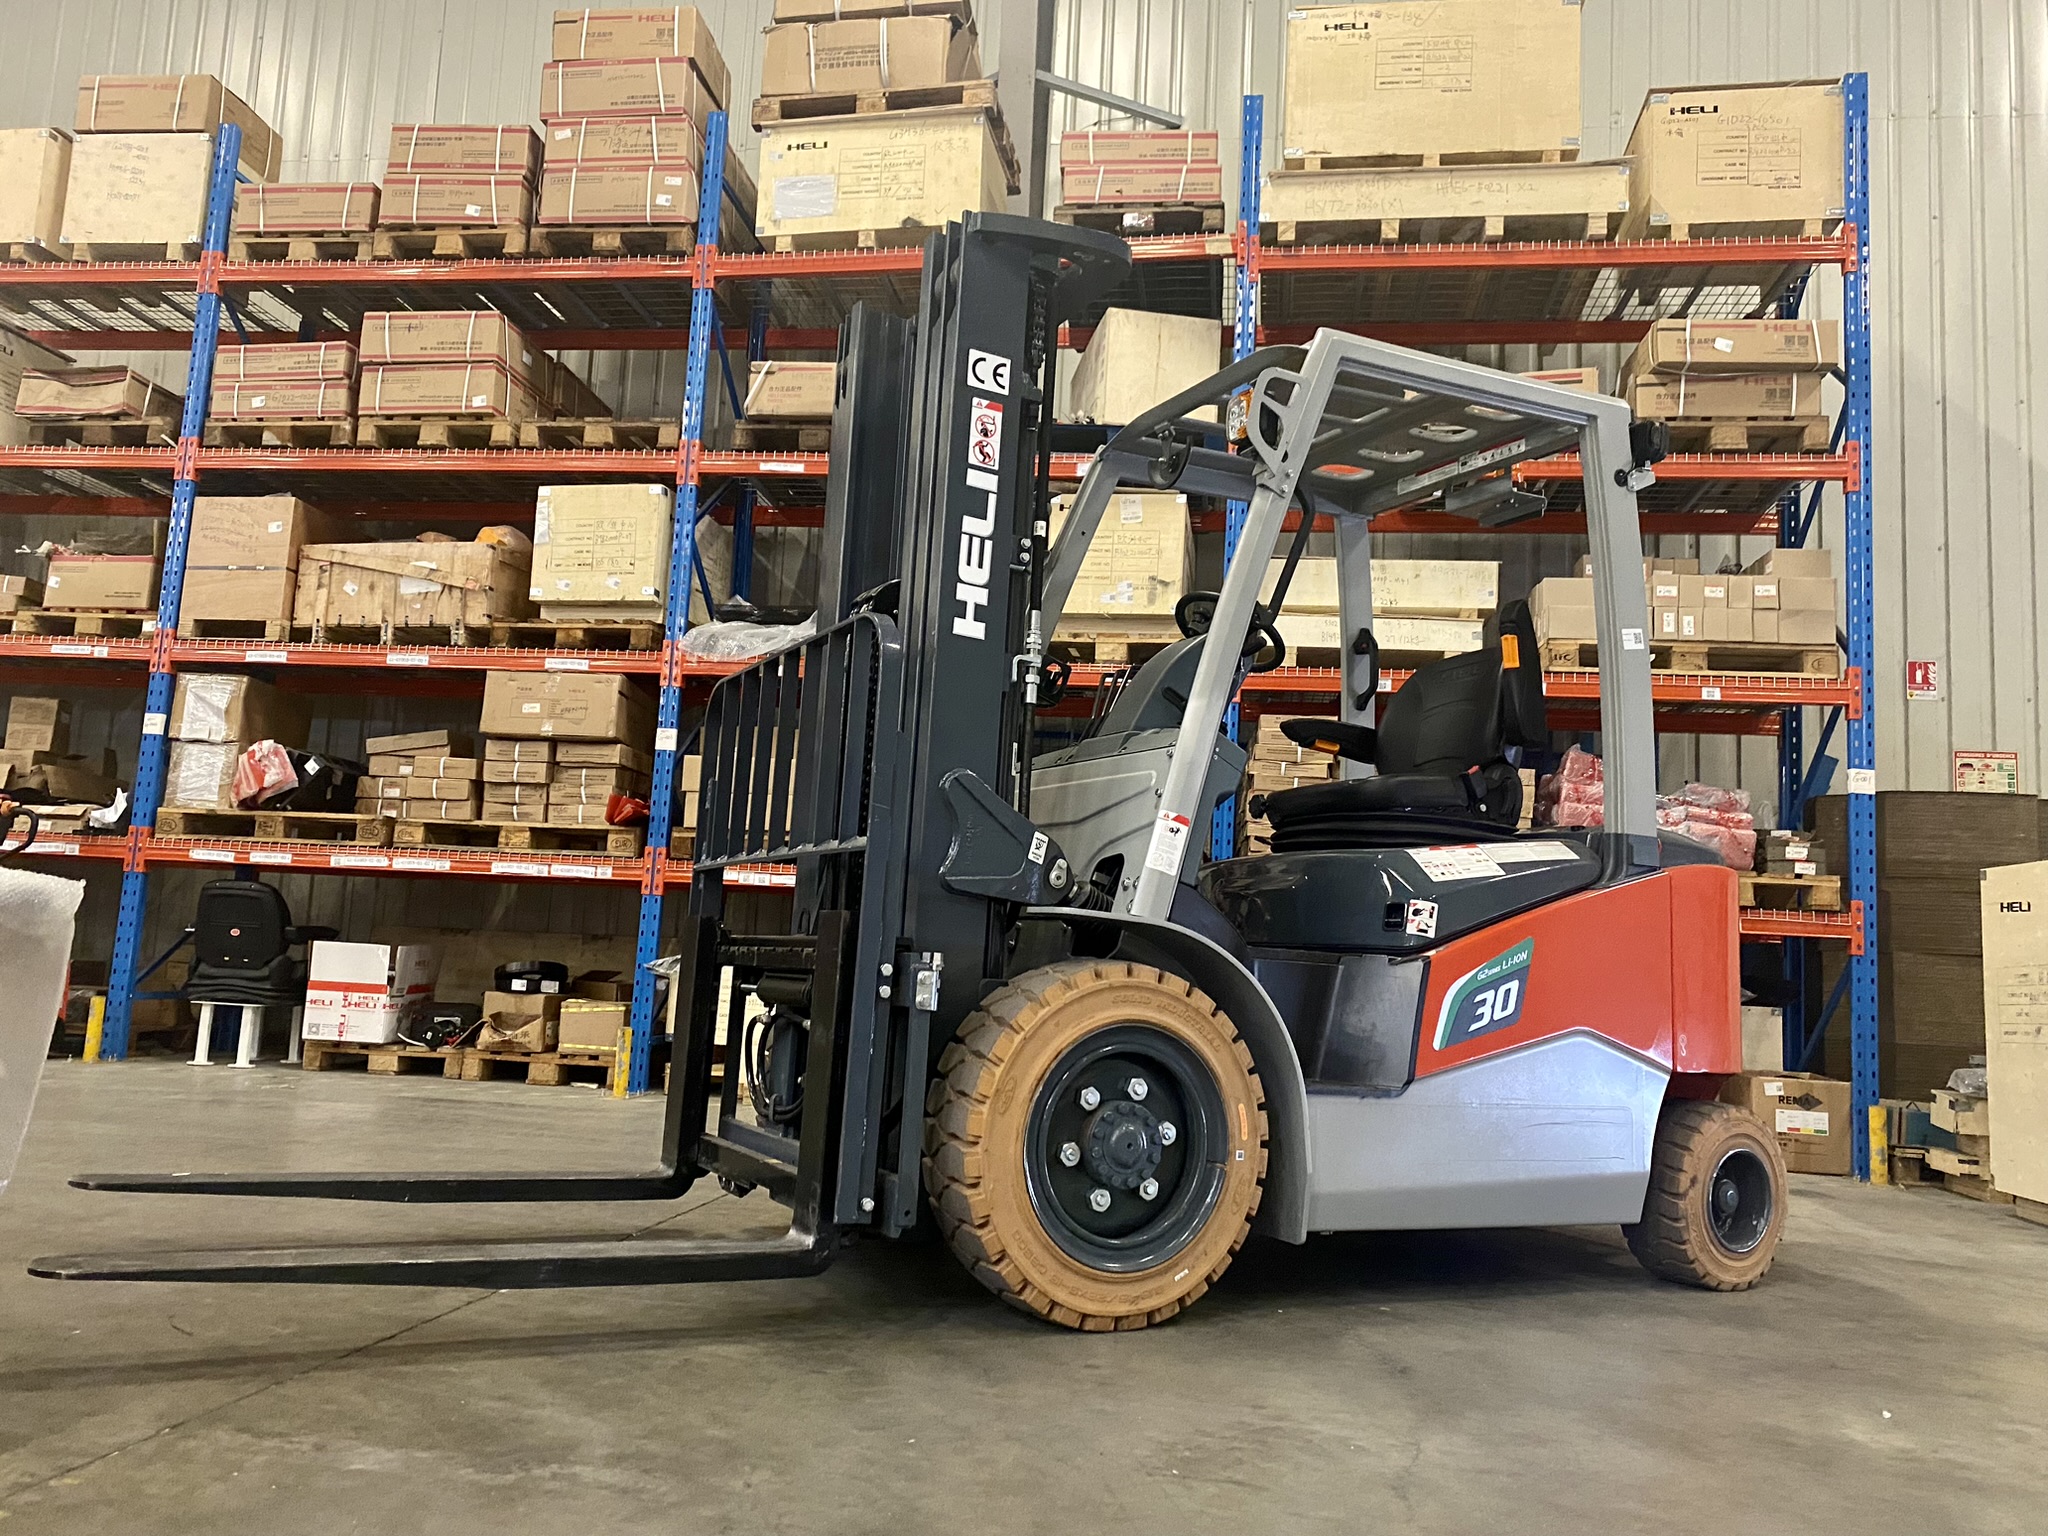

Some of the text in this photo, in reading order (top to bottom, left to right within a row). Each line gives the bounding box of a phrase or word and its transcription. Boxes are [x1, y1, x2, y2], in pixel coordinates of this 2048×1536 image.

[1324, 22, 1369, 32] HELI
[1669, 104, 1719, 116] HELI
[786, 140, 829, 152] HELI
[1762, 323, 1812, 333] HELI
[971, 356, 1008, 390] CE
[951, 467, 999, 641] HELI
[2000, 901, 2032, 913] HELI
[1111, 993, 1152, 1005] SOLID
[347, 1002, 378, 1010] HELI
[1468, 978, 1520, 1033] 30
